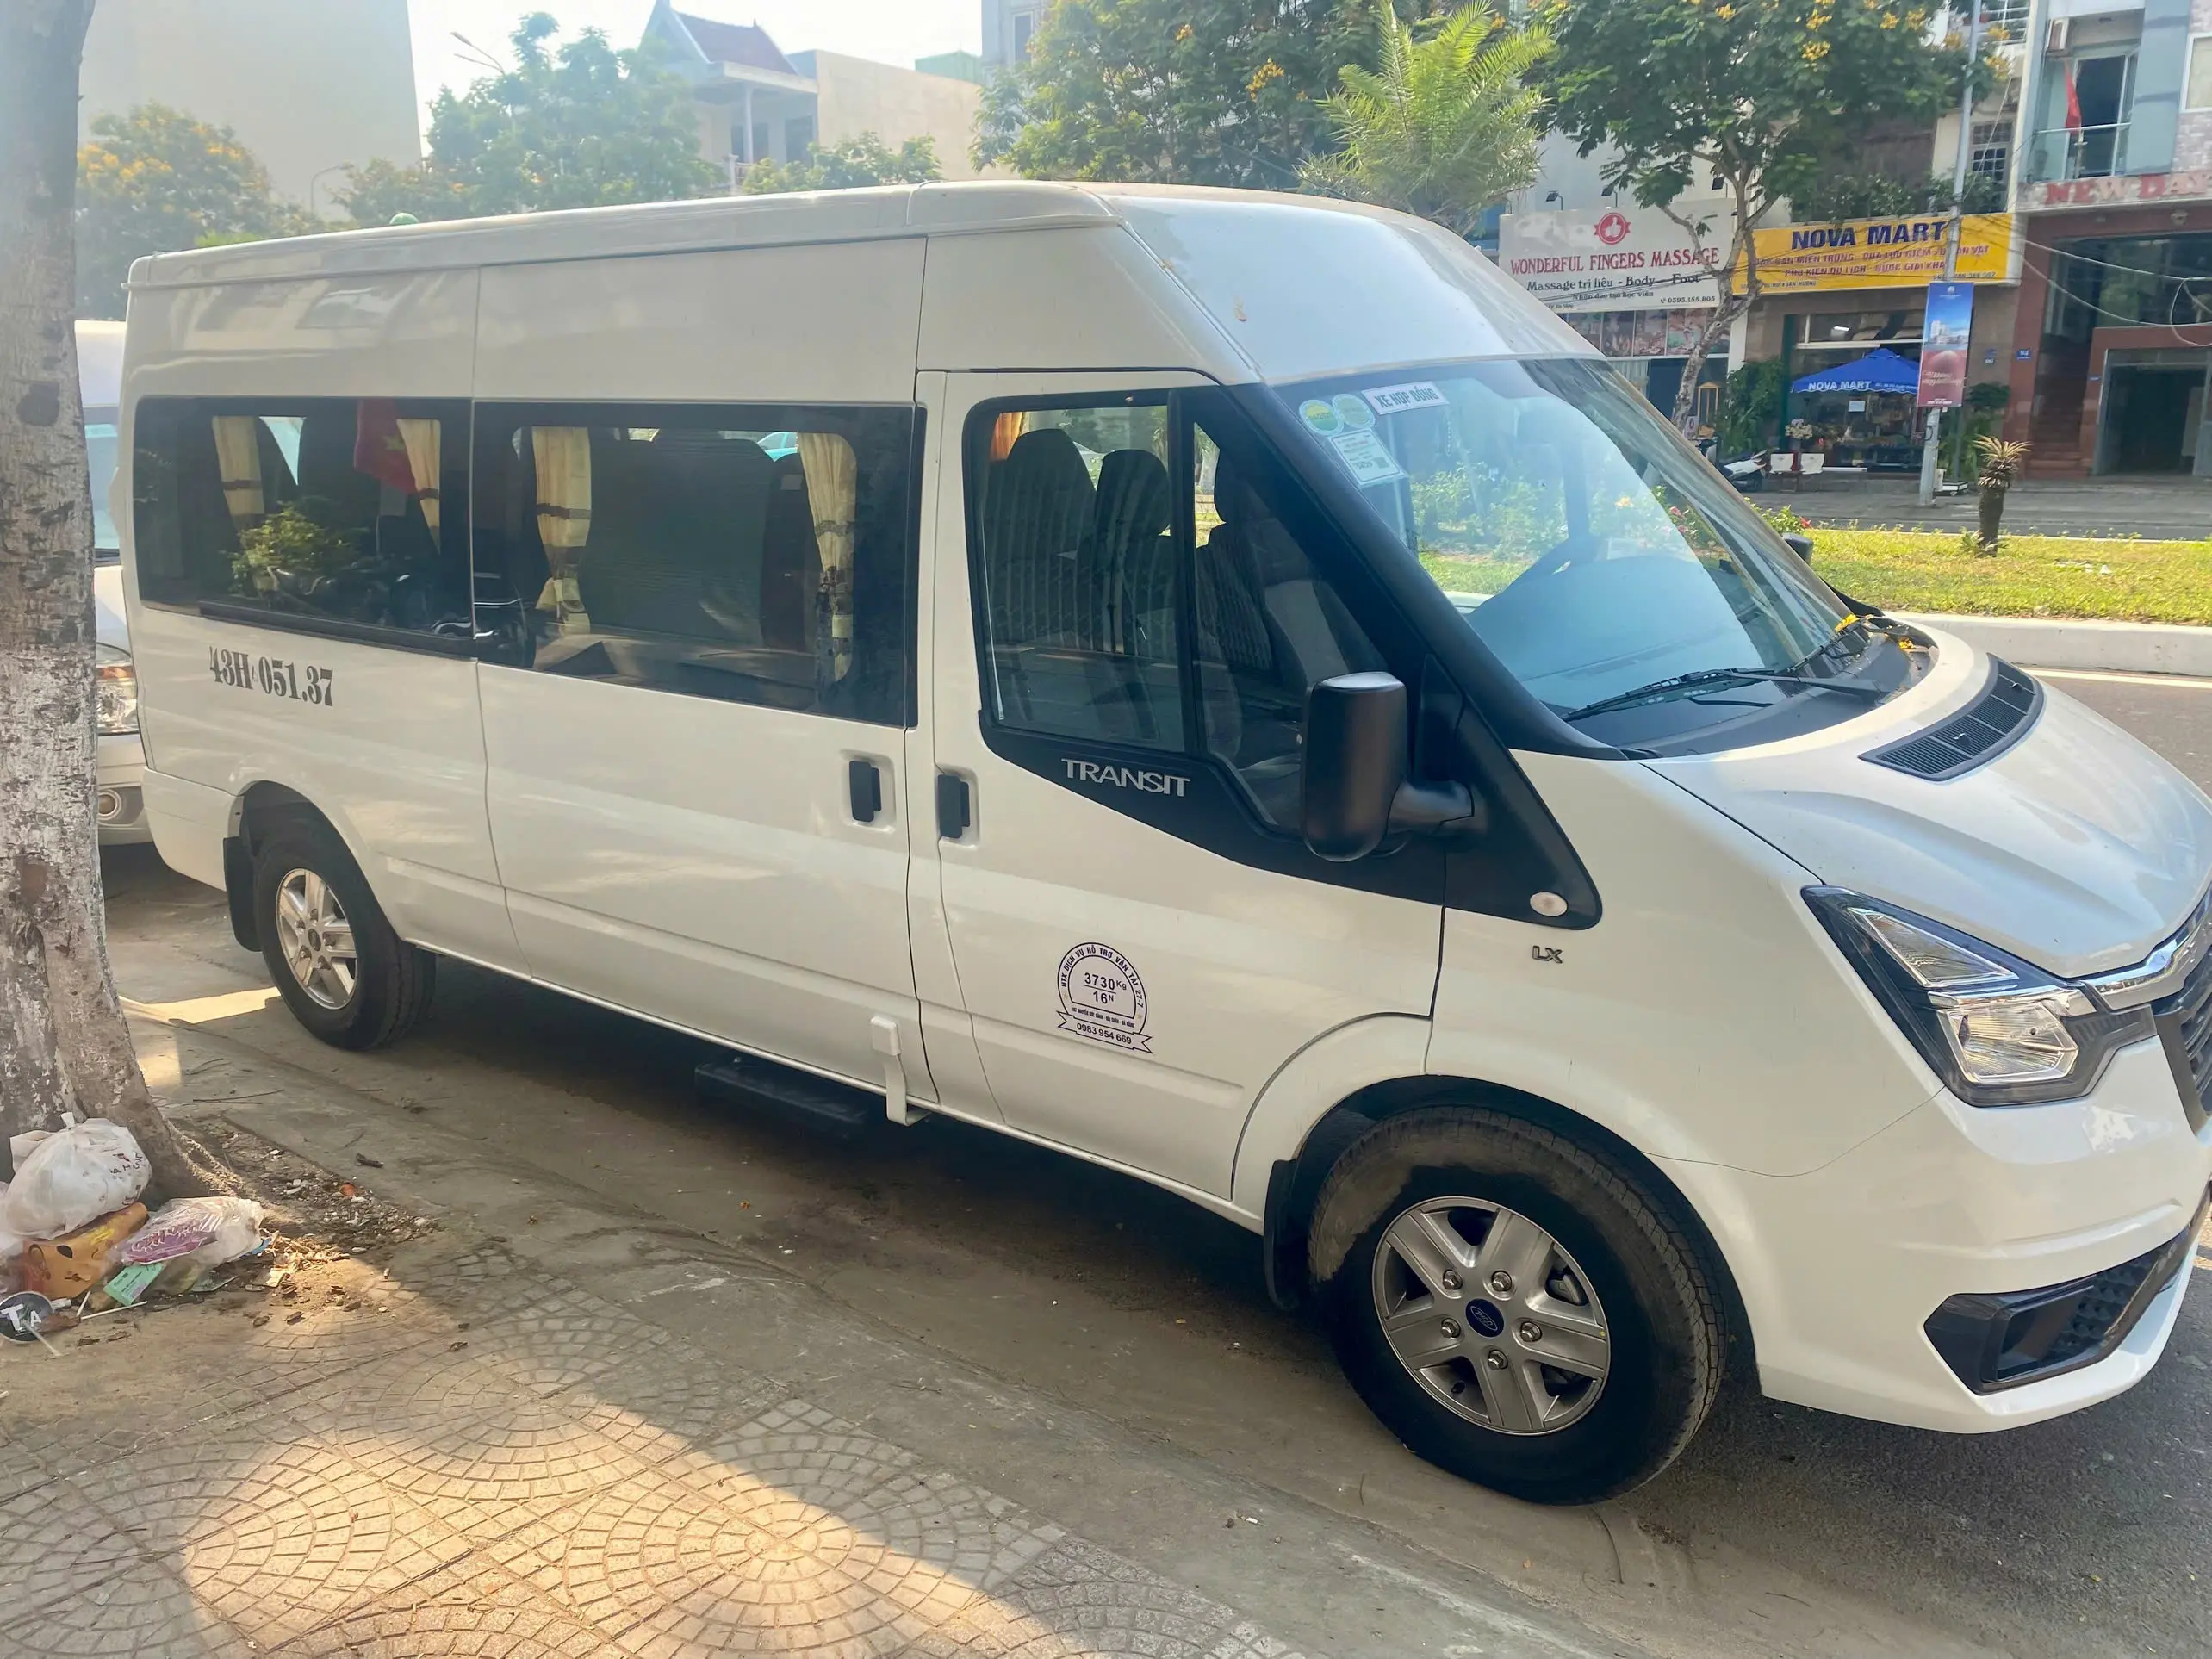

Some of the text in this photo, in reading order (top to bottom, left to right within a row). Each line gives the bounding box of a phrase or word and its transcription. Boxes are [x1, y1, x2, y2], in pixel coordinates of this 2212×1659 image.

[1792, 221, 1948, 250] NOVA MART
[1511, 247, 1720, 275] WONDERFUL FINGERS MASSAGE
[1526, 279, 1575, 291] Massage
[1625, 275, 1655, 287] Body
[1672, 273, 1701, 284] Foot
[1809, 382, 1838, 390] NOVA
[1840, 381, 1872, 390] MART
[1374, 395, 1394, 409] XE
[209, 646, 333, 706] 43H 051.37
[1061, 758, 1191, 798] TRANSIT
[1532, 946, 1563, 964] LX
[1064, 956, 1076, 972] DỊCH
[1135, 989, 1144, 1009] 27-7
[1077, 1022, 1132, 1045] 0983 954 669
